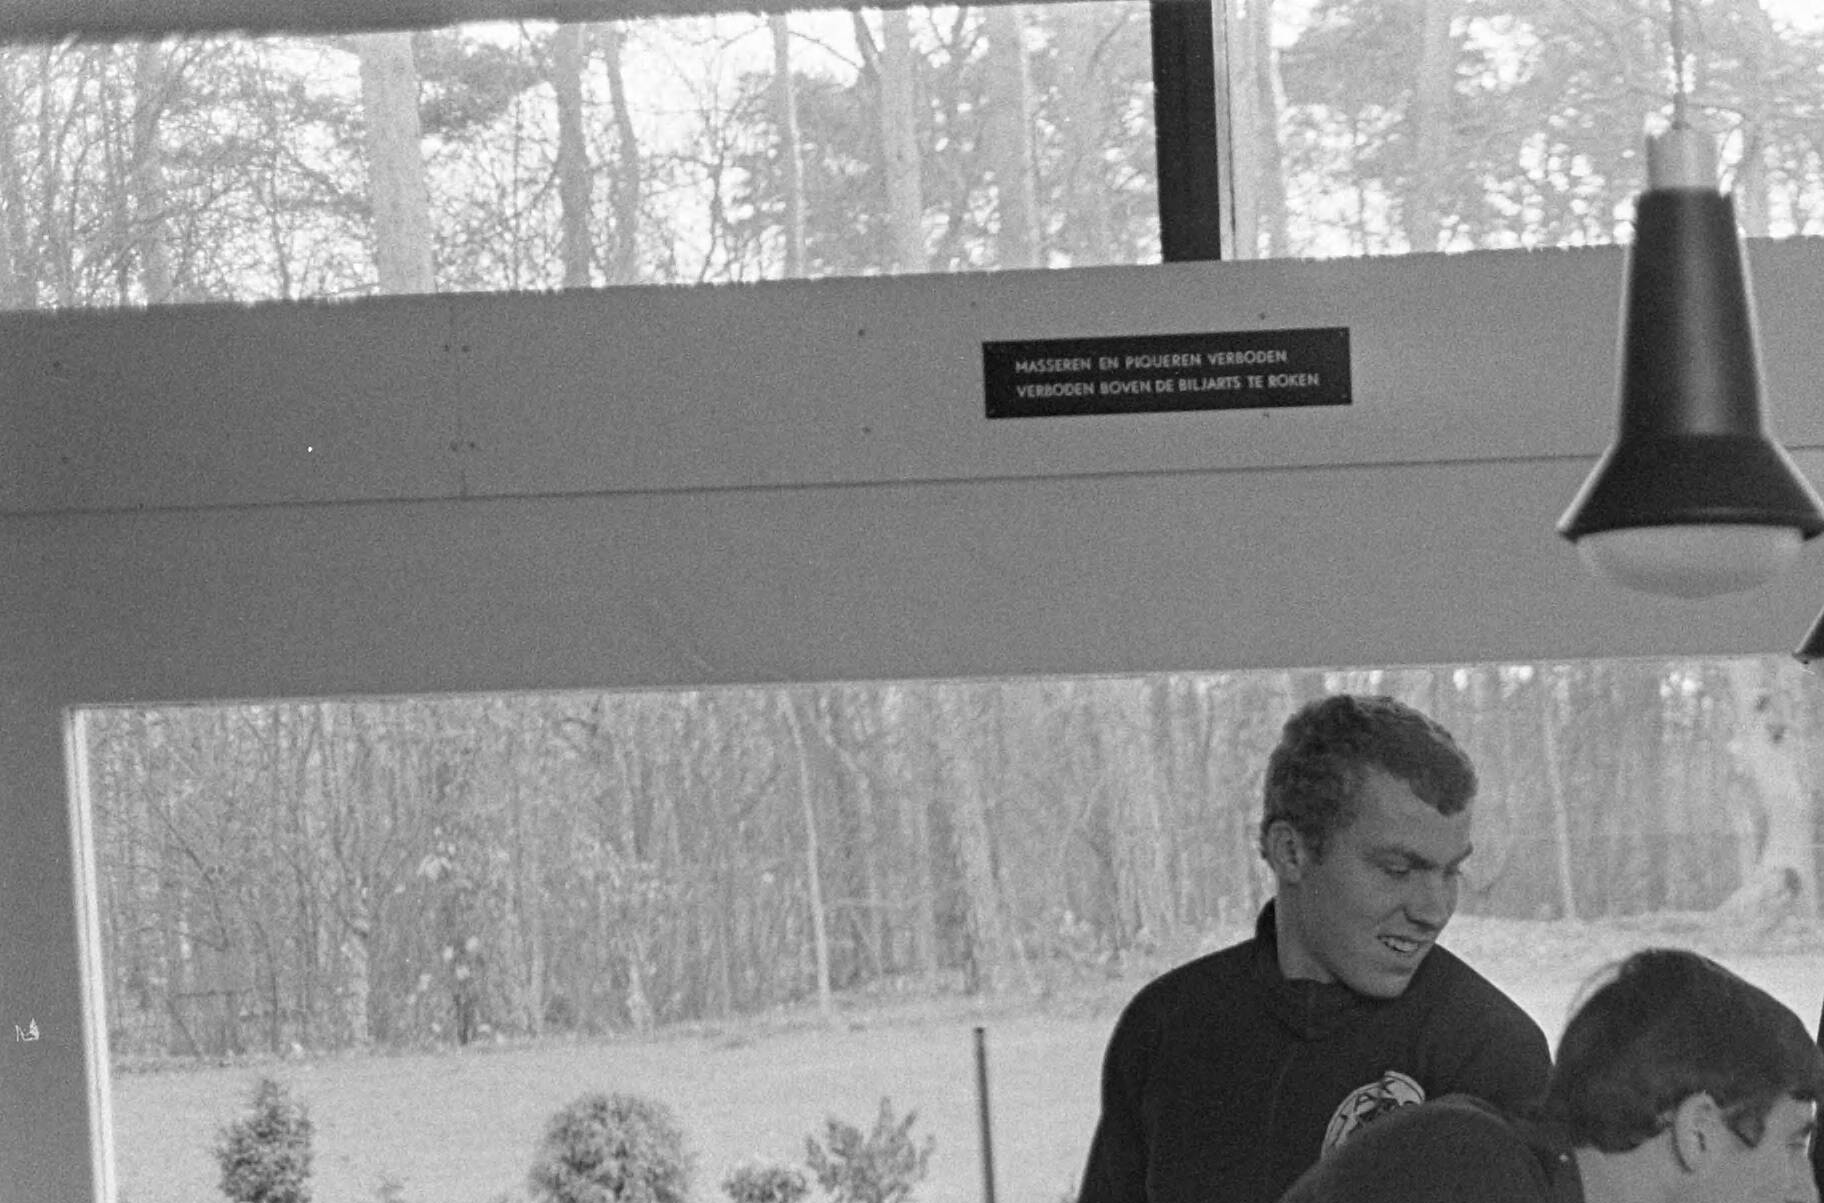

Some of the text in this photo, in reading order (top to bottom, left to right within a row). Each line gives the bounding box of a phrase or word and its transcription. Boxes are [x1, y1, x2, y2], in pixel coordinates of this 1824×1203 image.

[1015, 357, 1091, 373] MASSEREN
[1098, 355, 1119, 370] EN
[1207, 349, 1288, 365] VERBODEN
[1016, 372, 1321, 398] VERBODEN BOVEN DE BILJARTS TE ROKEN
